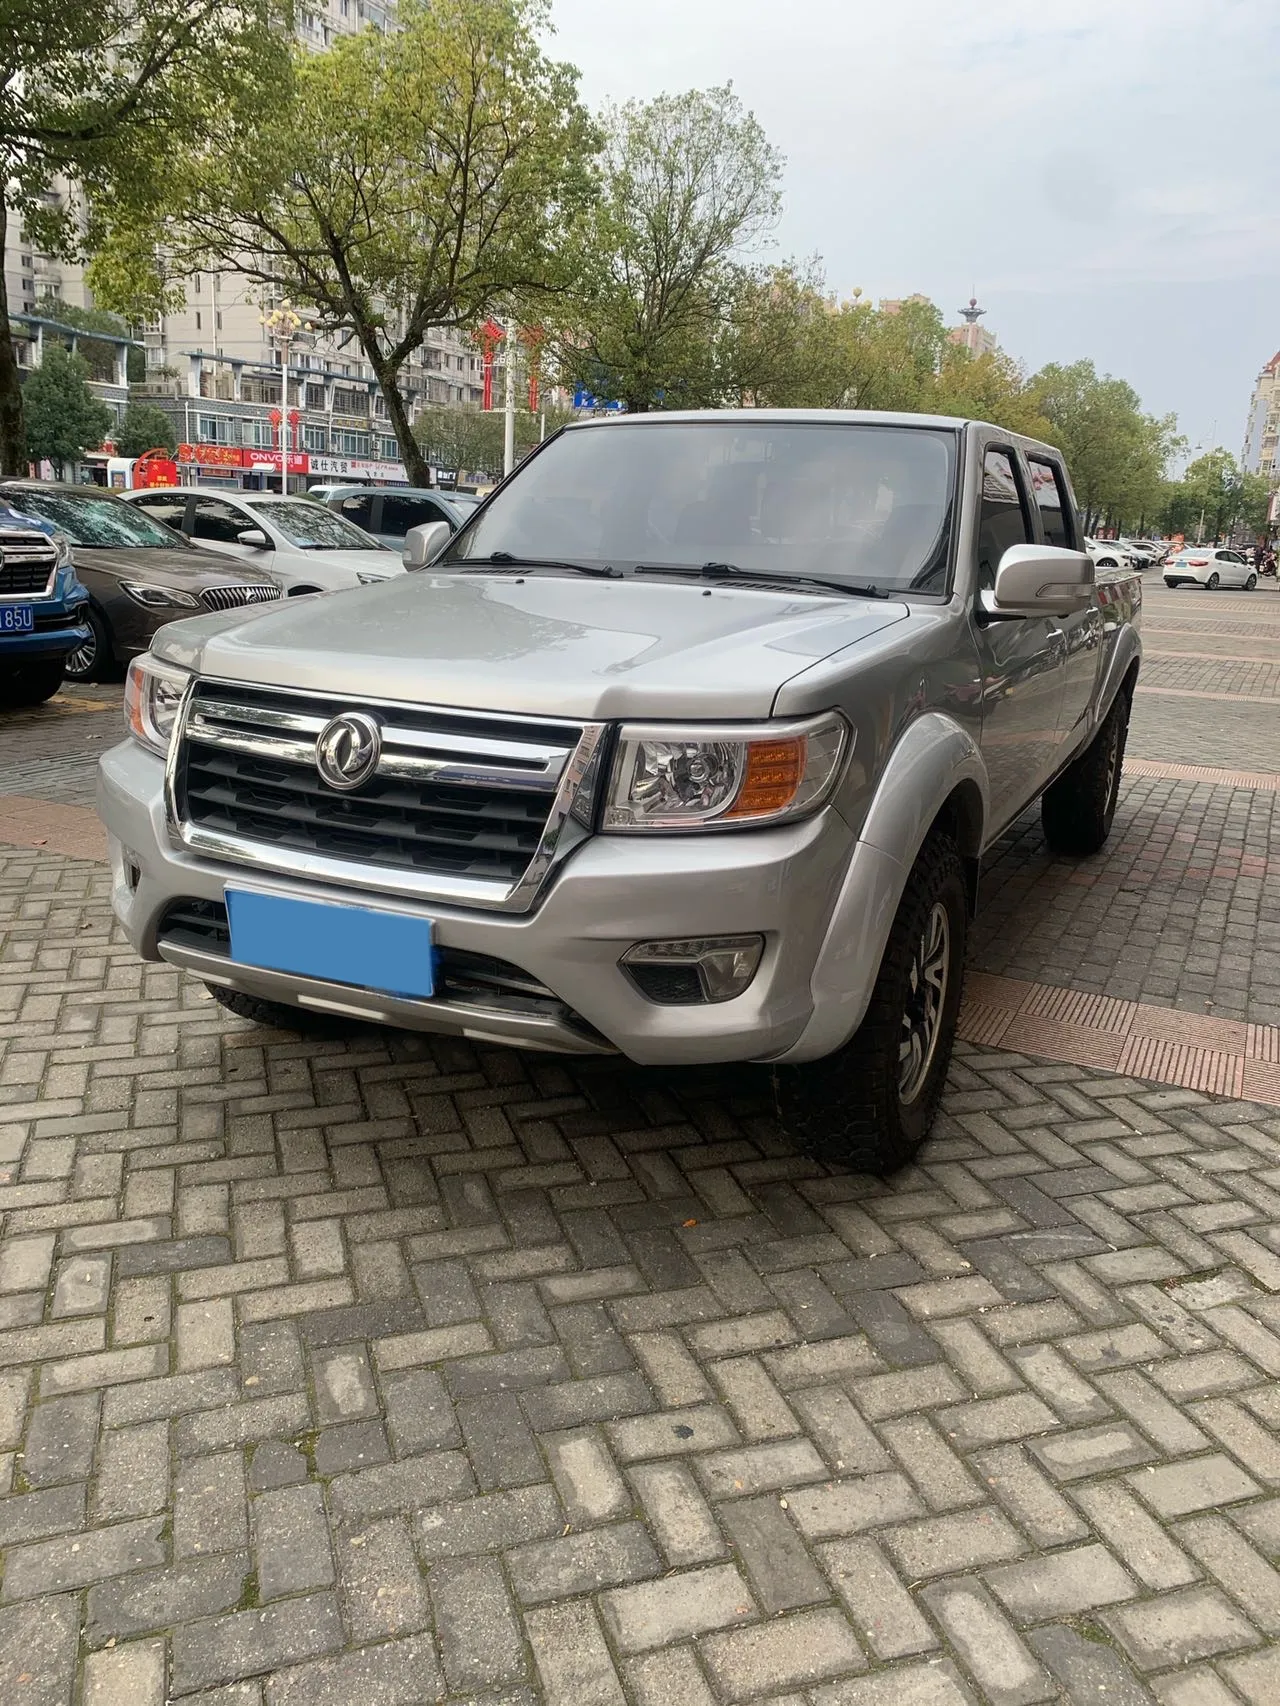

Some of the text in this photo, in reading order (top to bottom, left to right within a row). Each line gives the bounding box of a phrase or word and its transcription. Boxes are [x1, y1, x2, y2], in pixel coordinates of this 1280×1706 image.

[250, 452, 284, 462] ONVO
[310, 458, 348, 473] 诚仕汽贸
[0, 609, 32, 628] 85U
